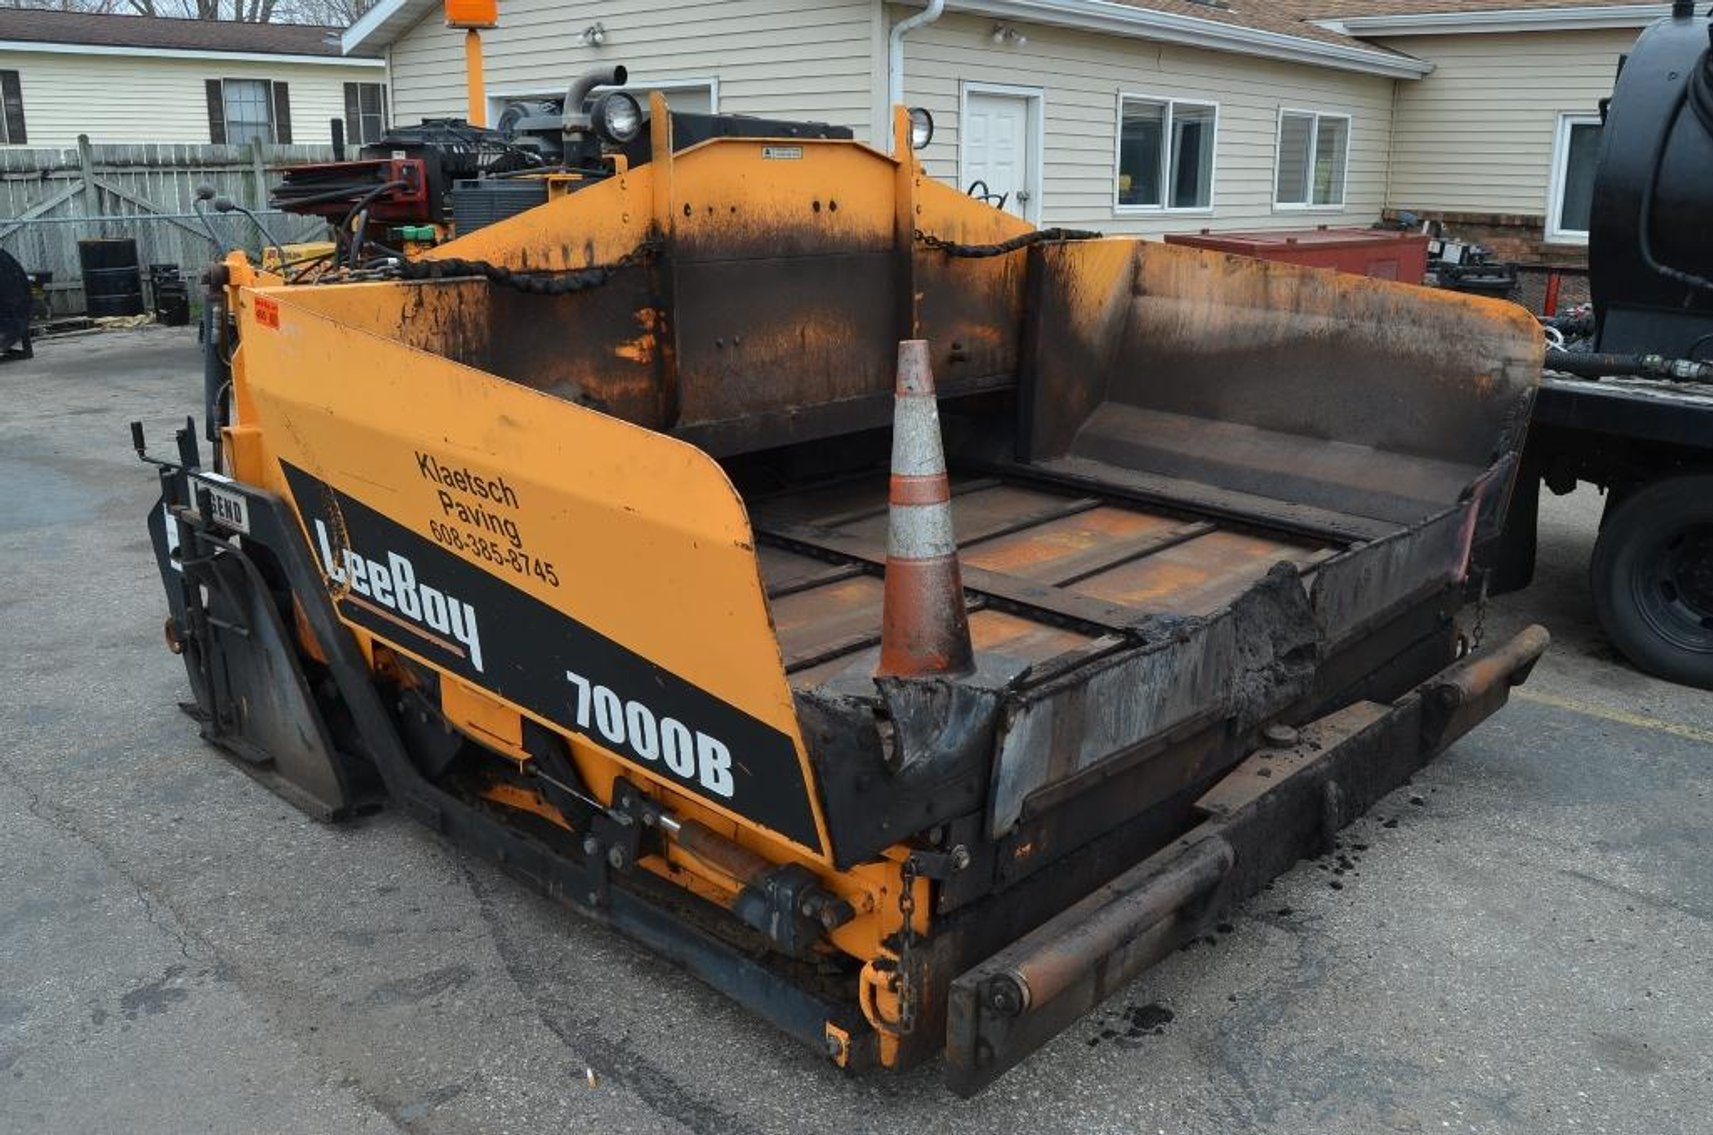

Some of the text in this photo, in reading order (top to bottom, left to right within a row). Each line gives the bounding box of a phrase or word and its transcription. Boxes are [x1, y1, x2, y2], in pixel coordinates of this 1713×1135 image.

[415, 451, 520, 510] Klaetsch
[429, 519, 560, 588] 608-385-8745
[438, 489, 523, 549] Paving
[314, 518, 485, 674] LeeBoy
[566, 670, 735, 798] 7000B
